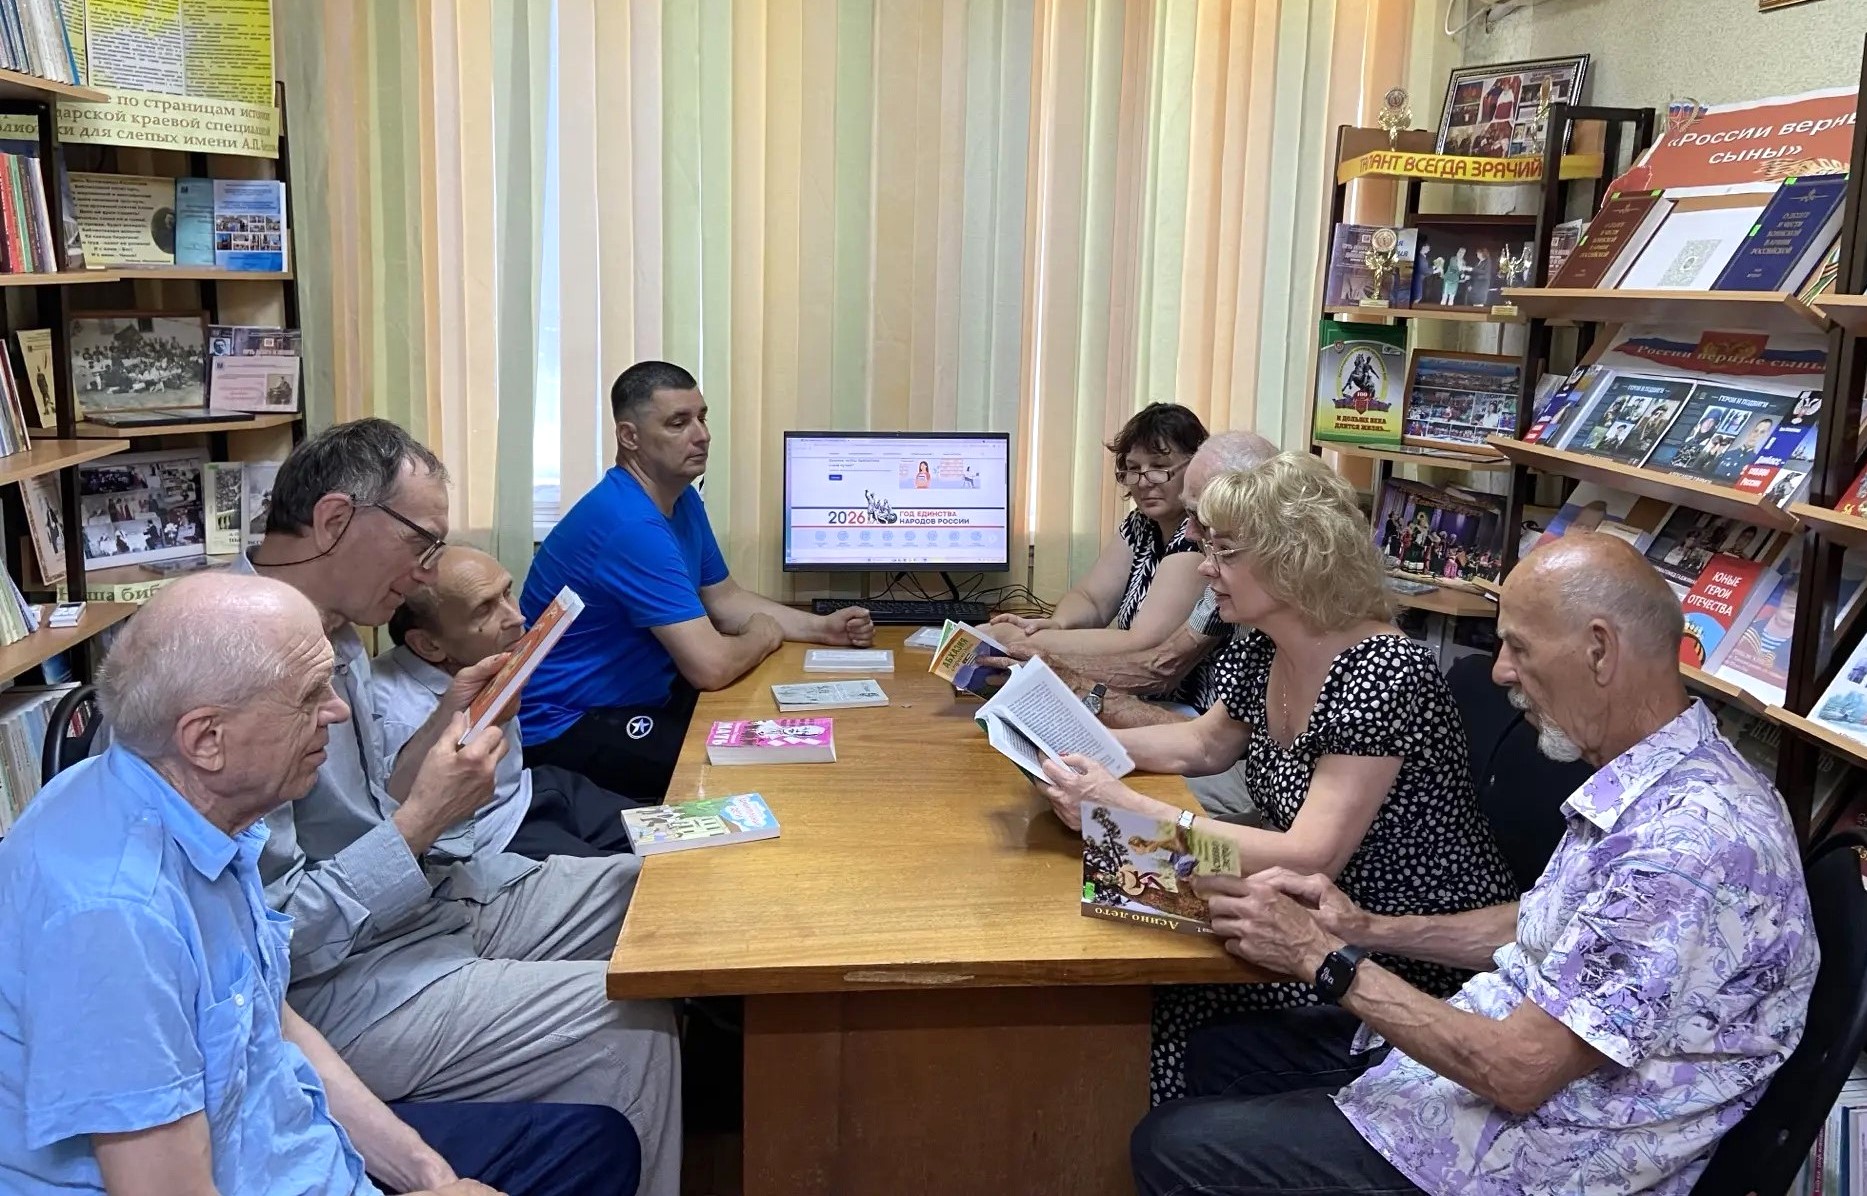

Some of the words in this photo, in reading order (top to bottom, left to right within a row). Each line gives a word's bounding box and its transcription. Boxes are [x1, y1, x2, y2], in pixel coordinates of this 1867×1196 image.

[117, 95, 139, 107] по
[144, 98, 235, 116] страницам
[131, 113, 200, 128] краевой
[80, 126, 112, 139] для
[117, 129, 179, 143] слепых
[184, 135, 237, 148] имени
[1668, 125, 1774, 147] «России
[1708, 145, 1803, 164] сыны»
[1404, 156, 1468, 177] ВСЕГДА
[1471, 157, 1543, 178] ЗРЯЧИЙ
[828, 510, 866, 525] 2026
[900, 510, 915, 518] ГОД
[917, 510, 957, 518] ЕДИНСТВА
[1712, 571, 1743, 587] ЮНЫЕ
[1704, 584, 1733, 600] ГЕРОИ
[1687, 594, 1734, 616] ОТЕЧЕСТВА
[942, 637, 969, 669] АБХАЗИЯ
[1094, 906, 1129, 919] лето
[1131, 913, 1179, 930] Асино
